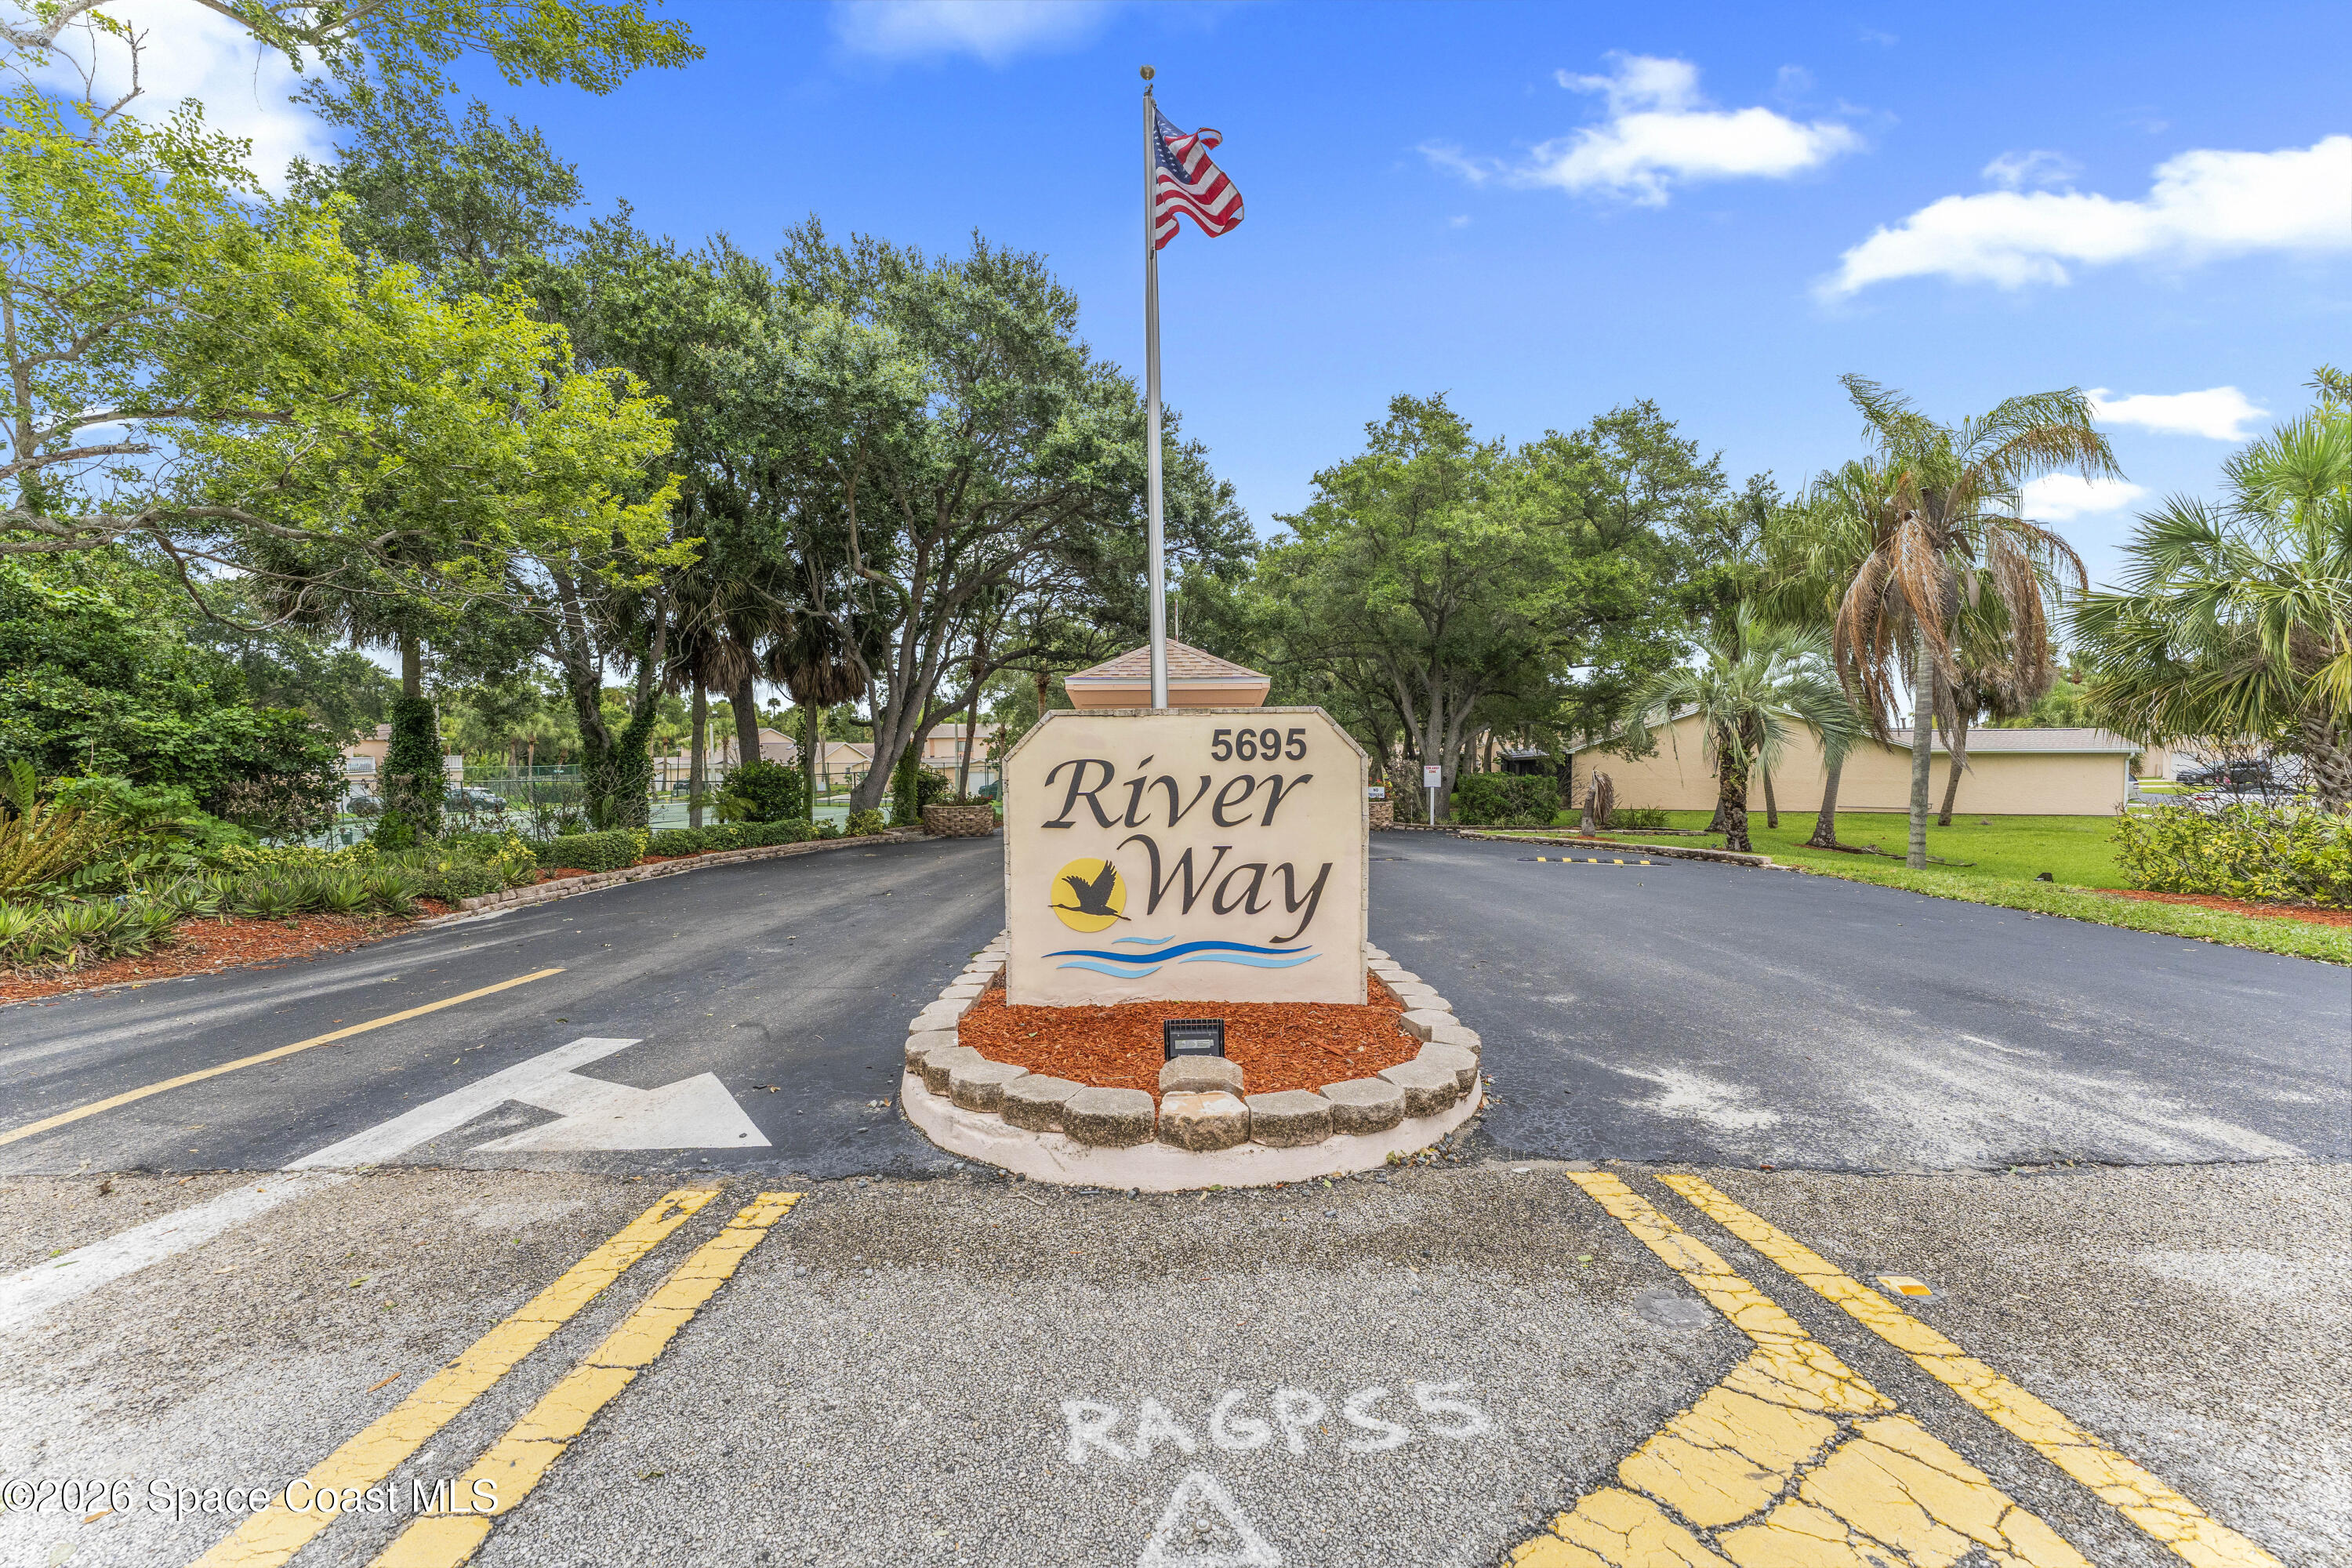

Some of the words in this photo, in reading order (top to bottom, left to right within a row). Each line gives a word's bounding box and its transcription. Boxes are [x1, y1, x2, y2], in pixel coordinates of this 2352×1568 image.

[1211, 728, 1307, 761] 5695
[1041, 754, 1314, 829] River
[1116, 833, 1334, 943] Way
